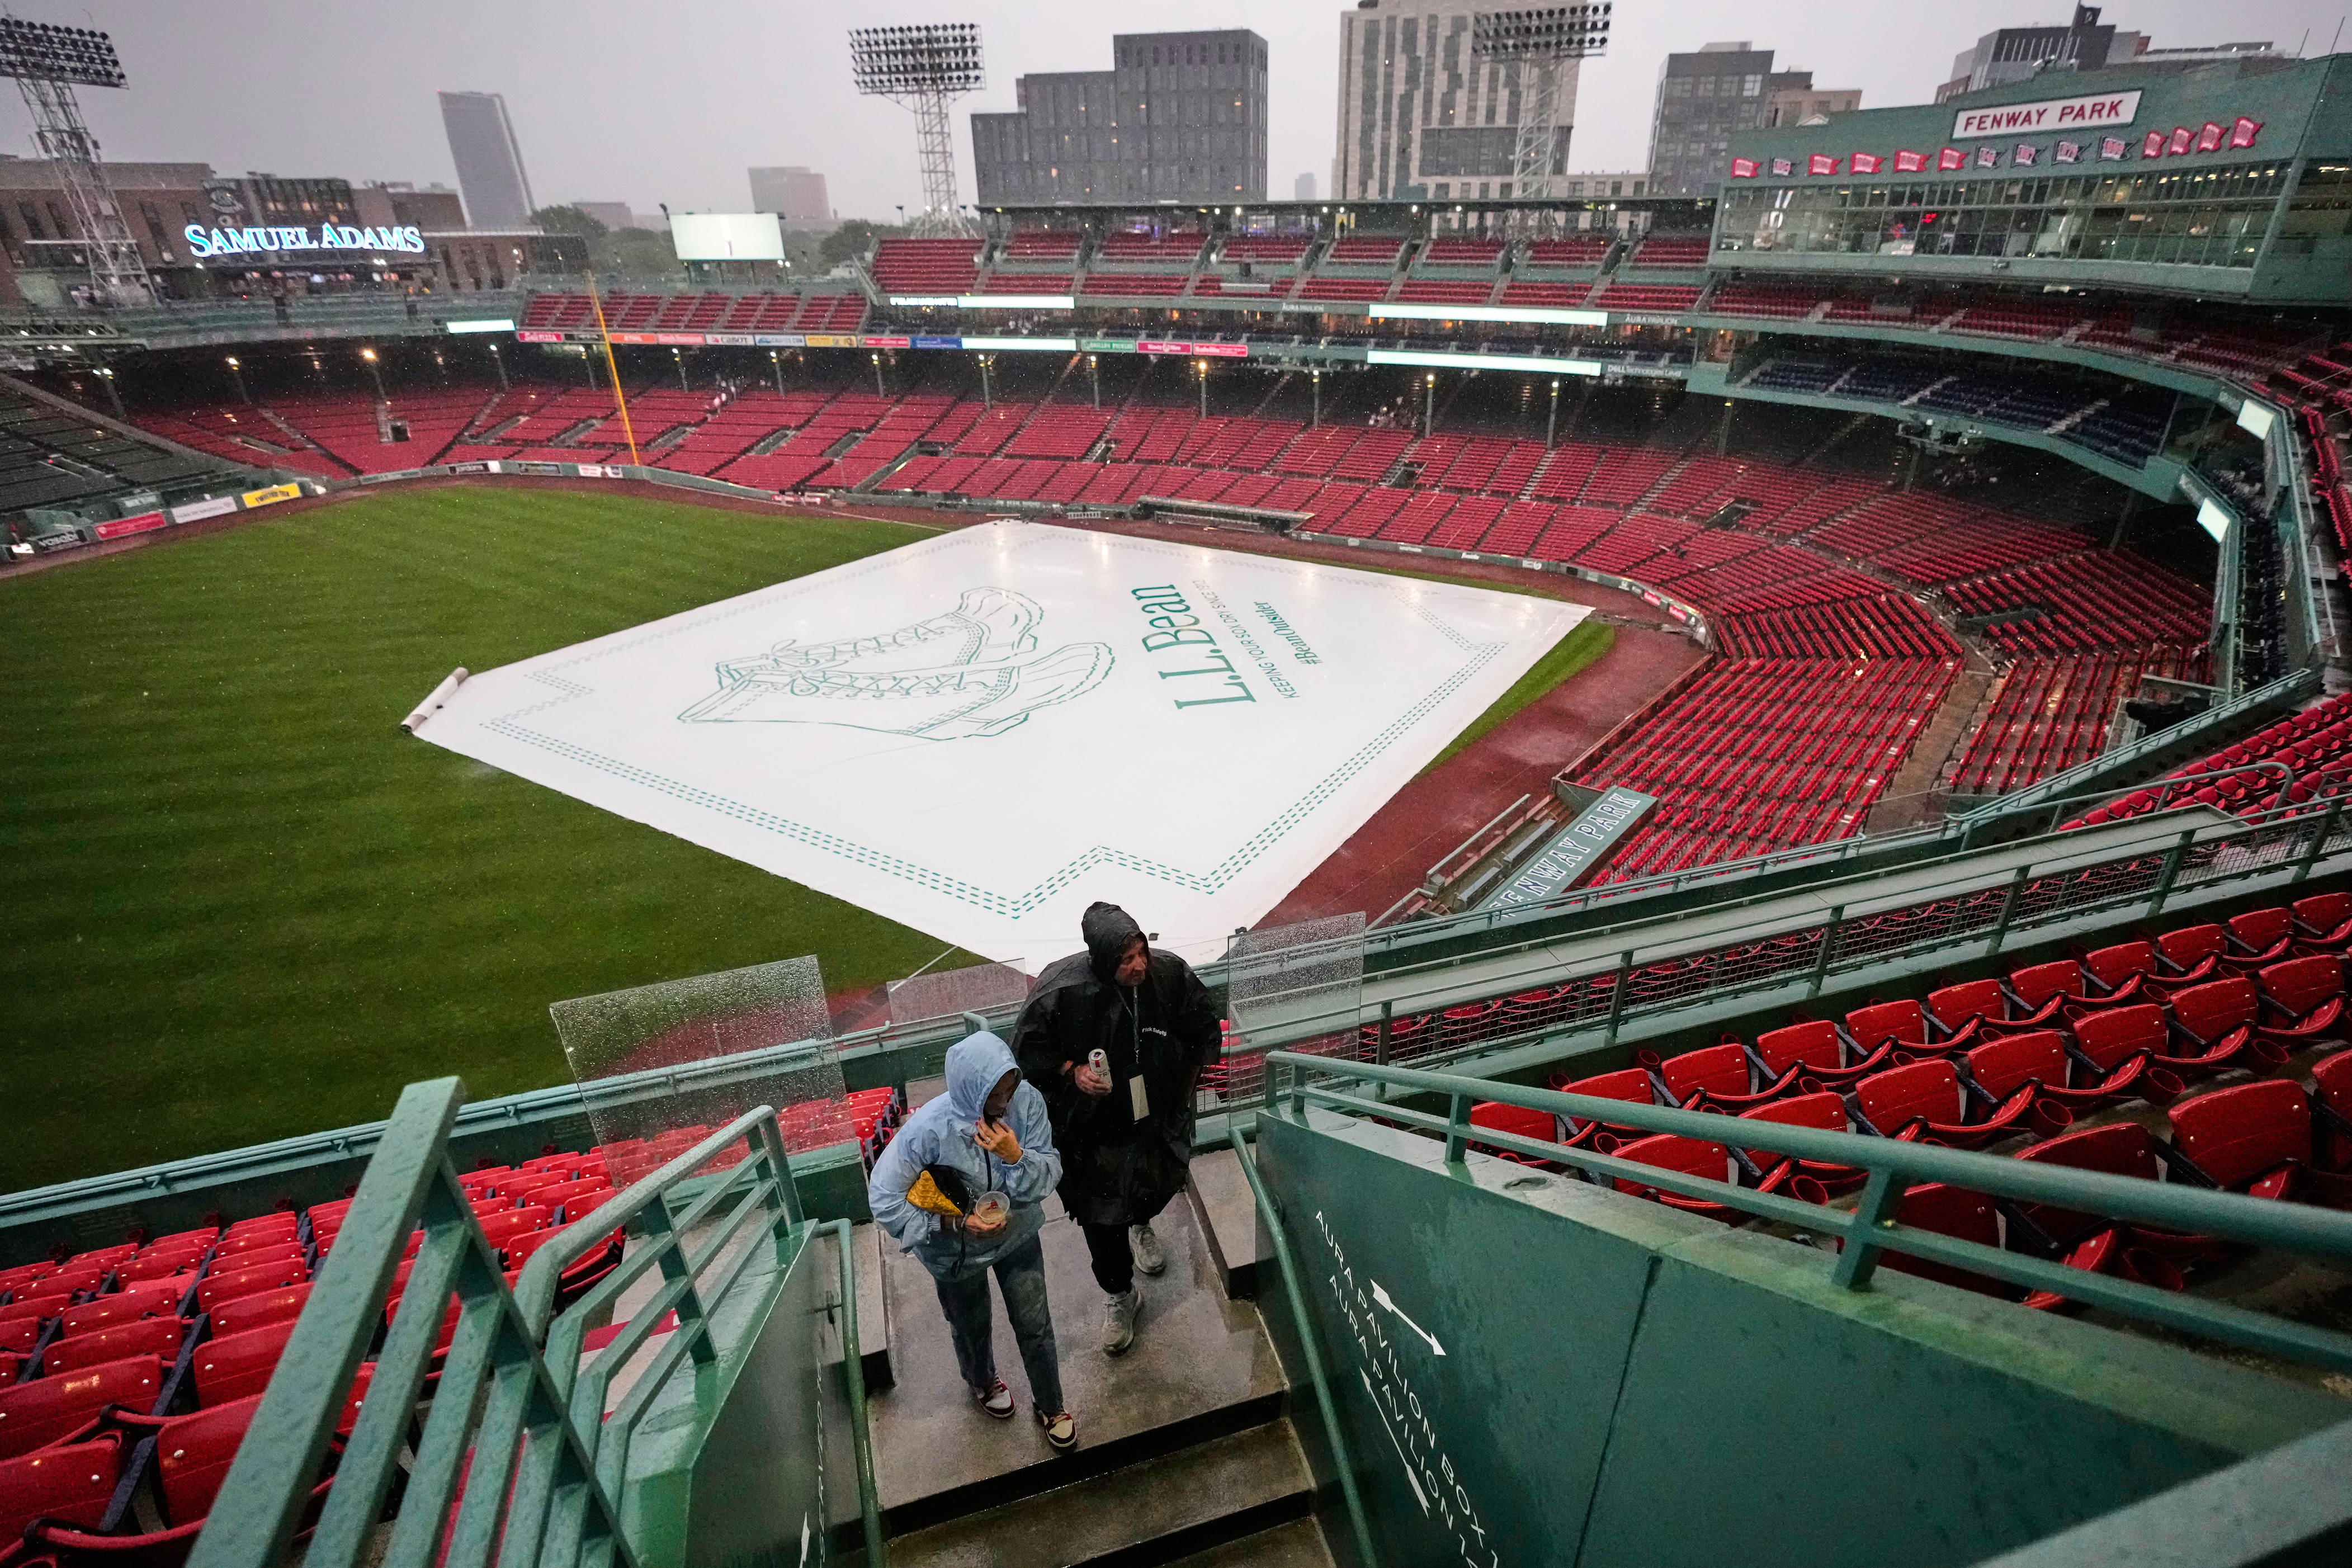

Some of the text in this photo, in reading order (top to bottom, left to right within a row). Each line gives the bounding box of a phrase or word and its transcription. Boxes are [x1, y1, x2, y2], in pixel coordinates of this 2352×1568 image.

[1963, 100, 2123, 132] FENWAY PARK
[1202, 590, 1226, 610] SINCE
[1217, 610, 1238, 624] DRY
[1229, 624, 1251, 639] SOX
[1253, 601, 1324, 665] #BeanOutsider
[1240, 639, 1268, 662] YOUR
[1258, 662, 1300, 699] KEEPING
[1574, 793, 1641, 840] PARK
[1153, 1027, 1166, 1037] Safety
[1316, 1211, 1353, 1289] AURA
[1357, 1287, 1435, 1449] PAVILION
[1442, 1453, 1485, 1548] BOX
[1329, 1275, 1368, 1358] AURA
[1373, 1357, 1453, 1531] PAVILION
[817, 1400, 826, 1568] SERVED
